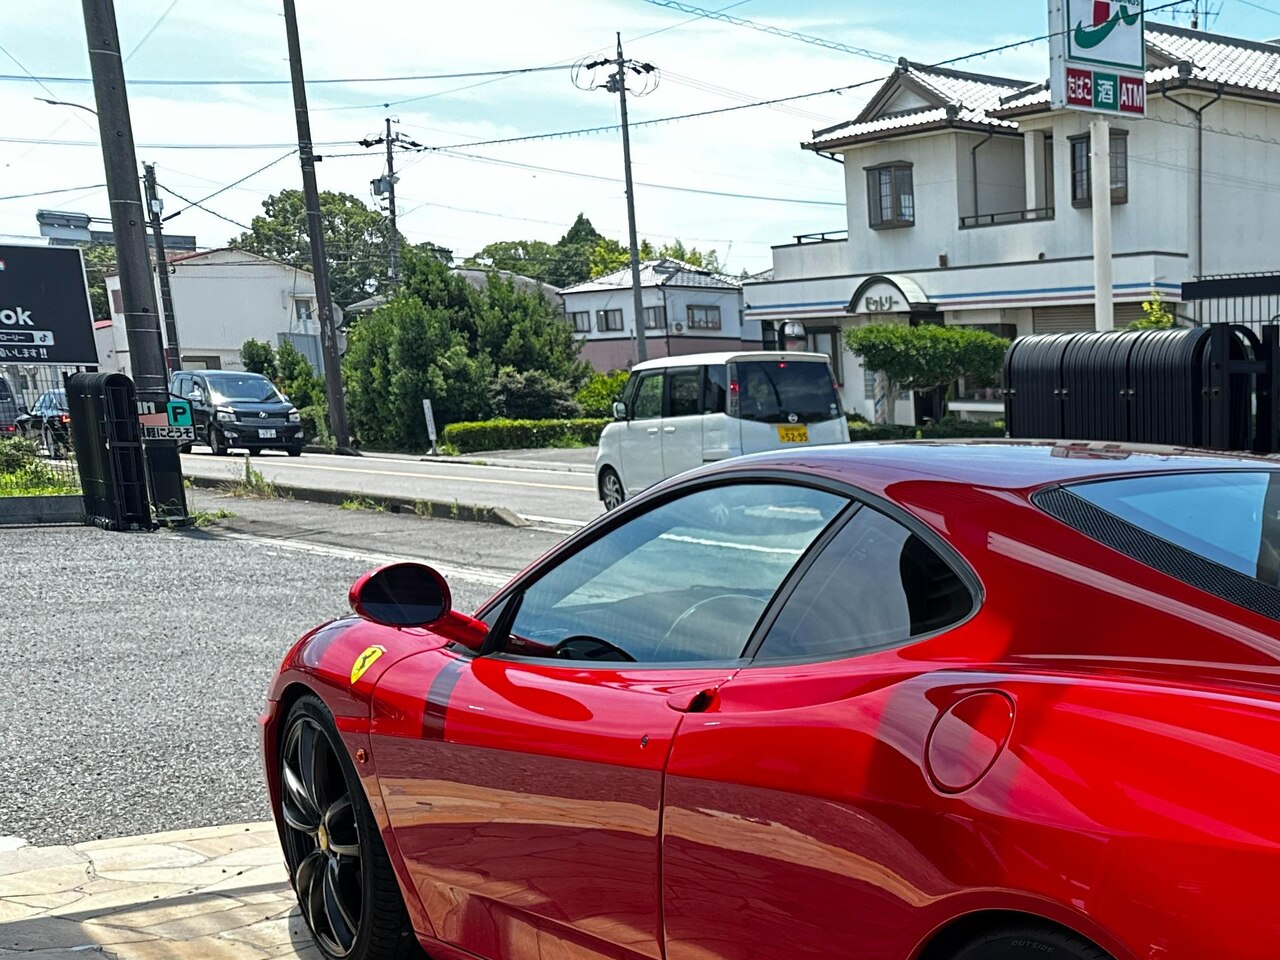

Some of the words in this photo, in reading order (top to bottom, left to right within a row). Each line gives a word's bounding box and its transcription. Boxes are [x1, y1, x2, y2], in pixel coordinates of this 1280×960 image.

[1067, 75, 1092, 100] たばこ
[1098, 79, 1114, 104] 酒
[1120, 82, 1143, 107] ATM
[1010, 938, 1056, 954] OUTSIDE
